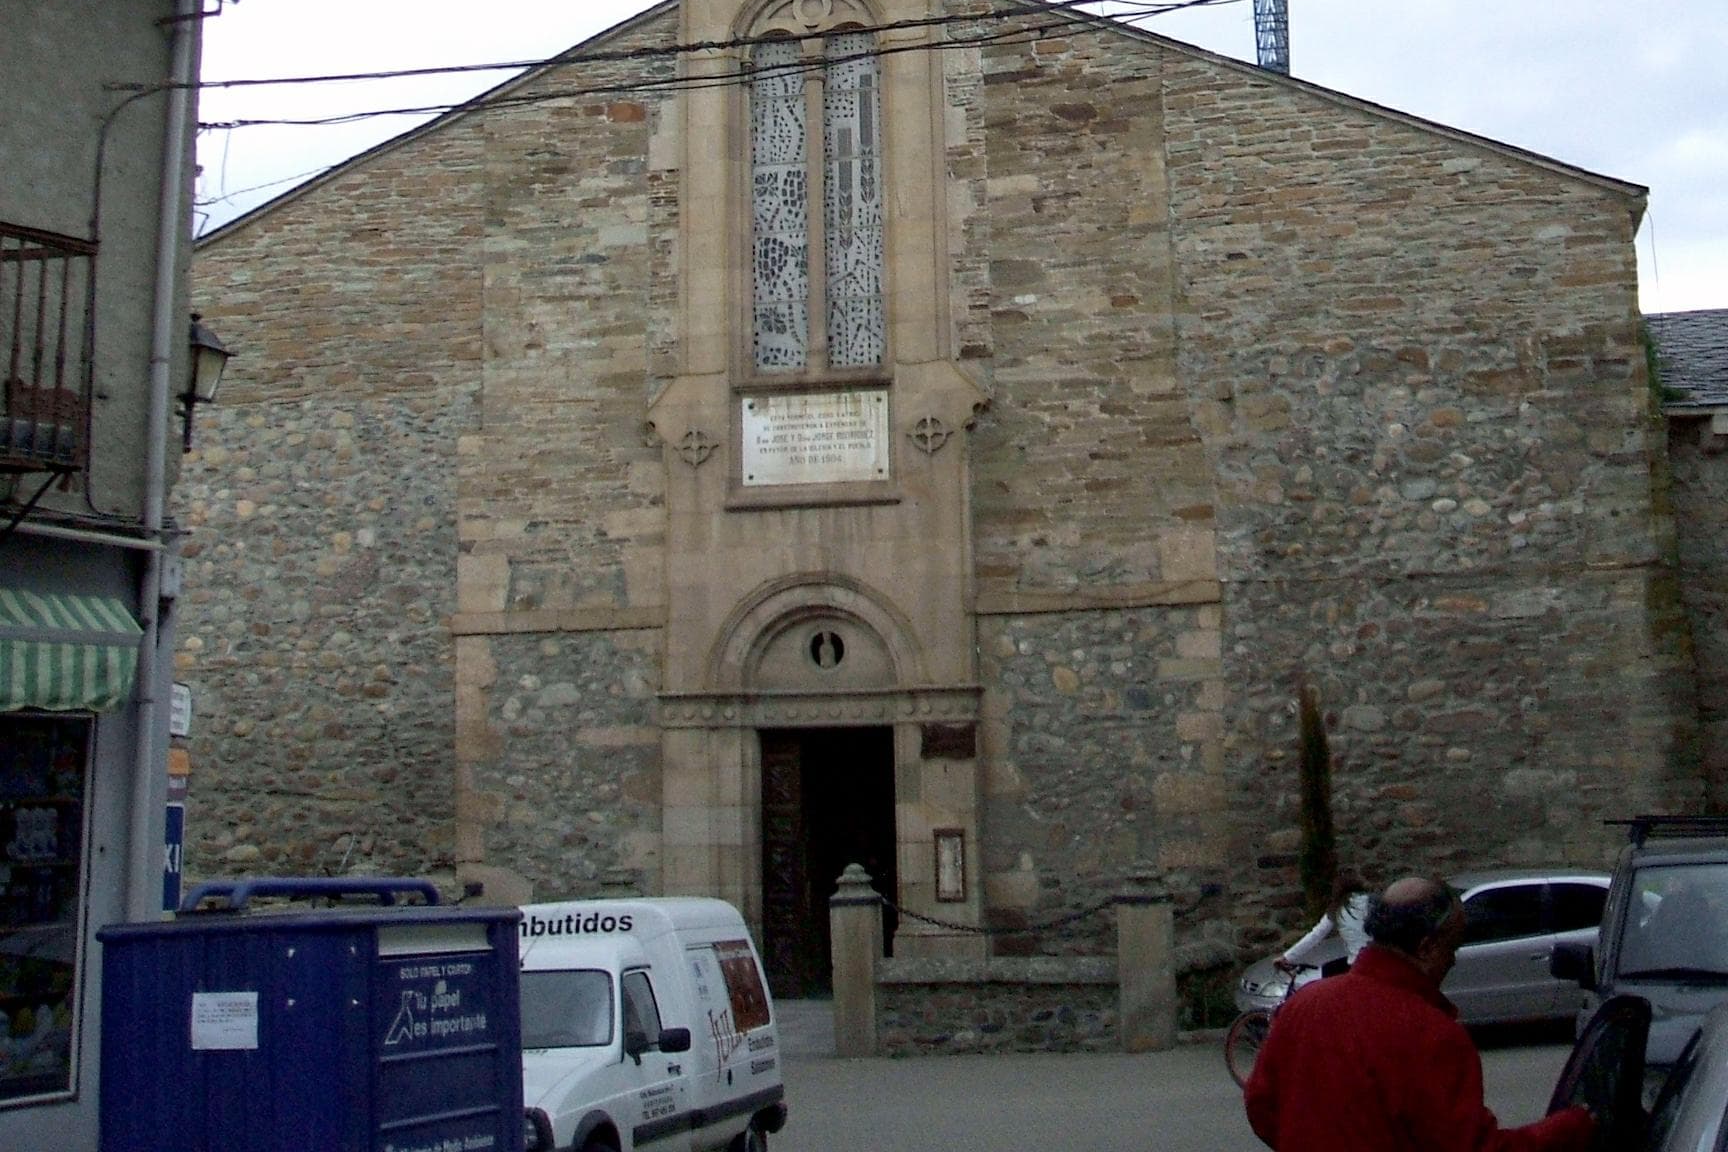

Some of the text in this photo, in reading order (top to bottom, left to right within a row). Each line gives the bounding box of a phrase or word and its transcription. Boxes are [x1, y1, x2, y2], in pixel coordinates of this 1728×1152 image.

[431, 989, 460, 1013] papel
[414, 1013, 487, 1037] es importante
